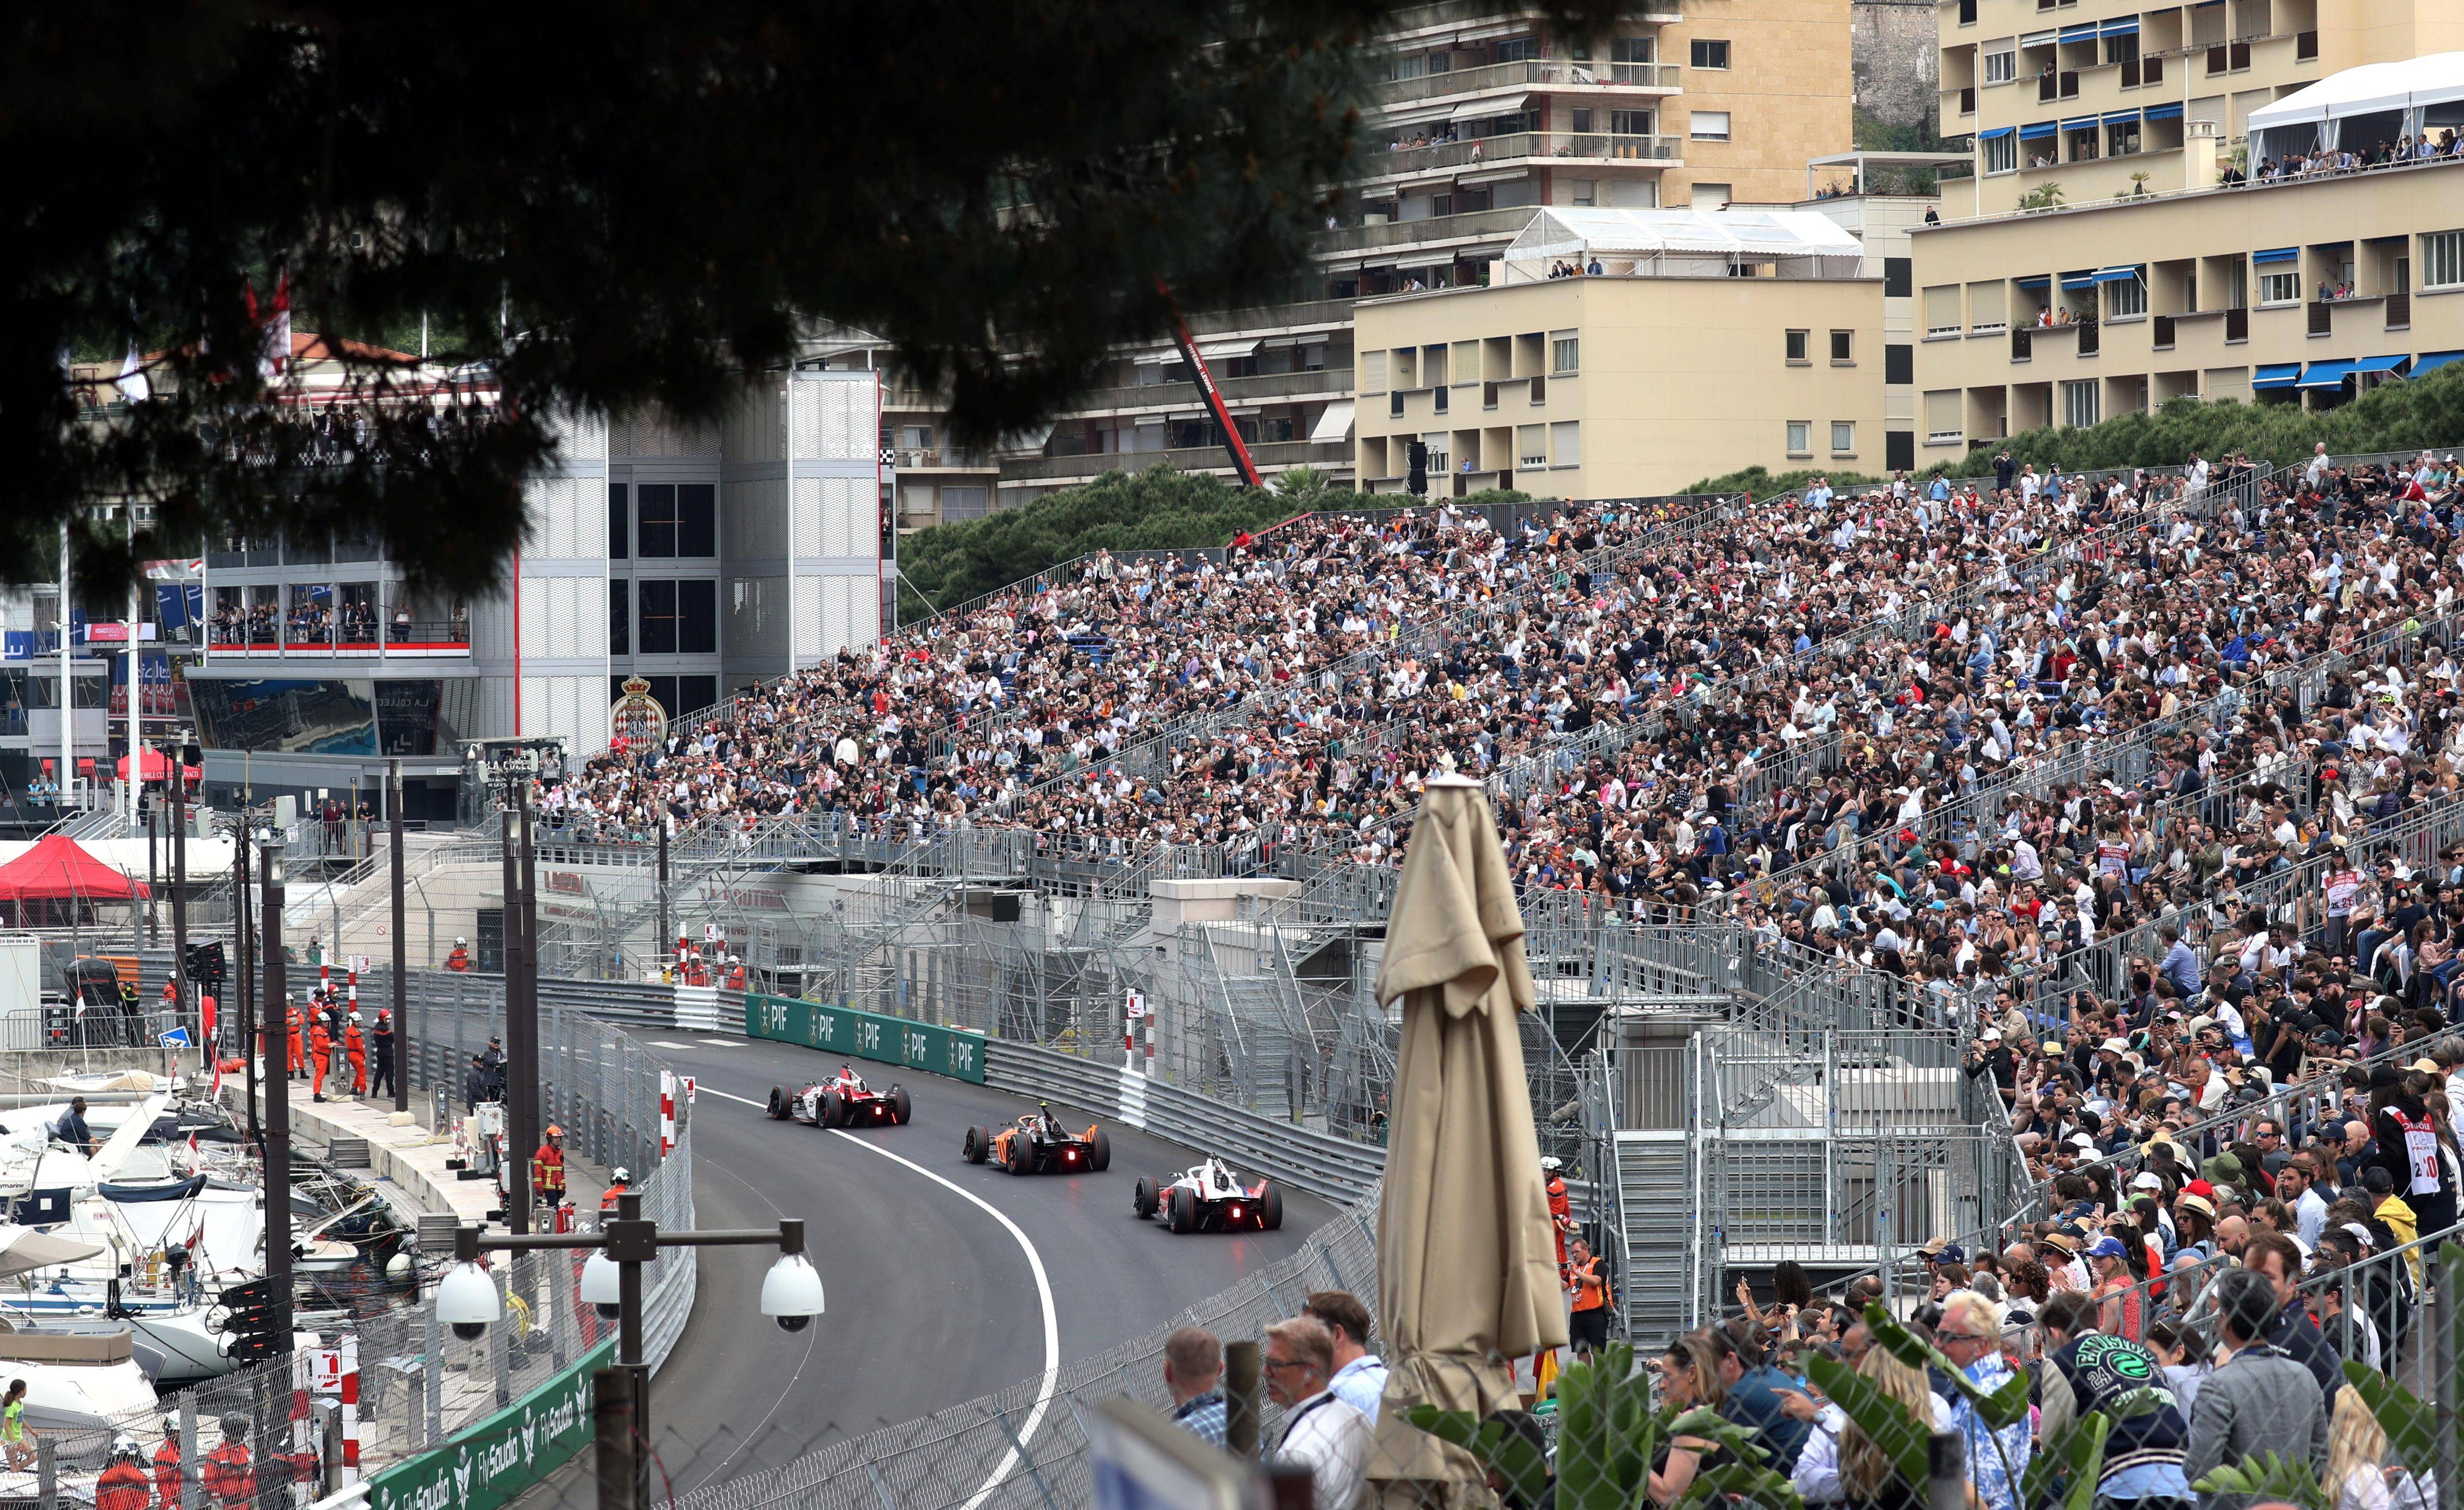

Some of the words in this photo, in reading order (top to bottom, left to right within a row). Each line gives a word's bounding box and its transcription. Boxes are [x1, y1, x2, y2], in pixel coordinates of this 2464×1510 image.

[1186, 343, 1203, 371] IMPERIAL
[1200, 371, 1215, 394] LEVAGE
[771, 1005, 787, 1031] PIF
[819, 1014, 834, 1042] PIF
[865, 1022, 880, 1051] PIF
[911, 1032, 926, 1062] PIF
[958, 1041, 973, 1071] PIF
[2076, 1334, 2156, 1368] ENVISION
[2087, 1366, 2113, 1391] 24
[540, 1391, 573, 1451] FlySaudia
[478, 1427, 518, 1491] FlySaudia
